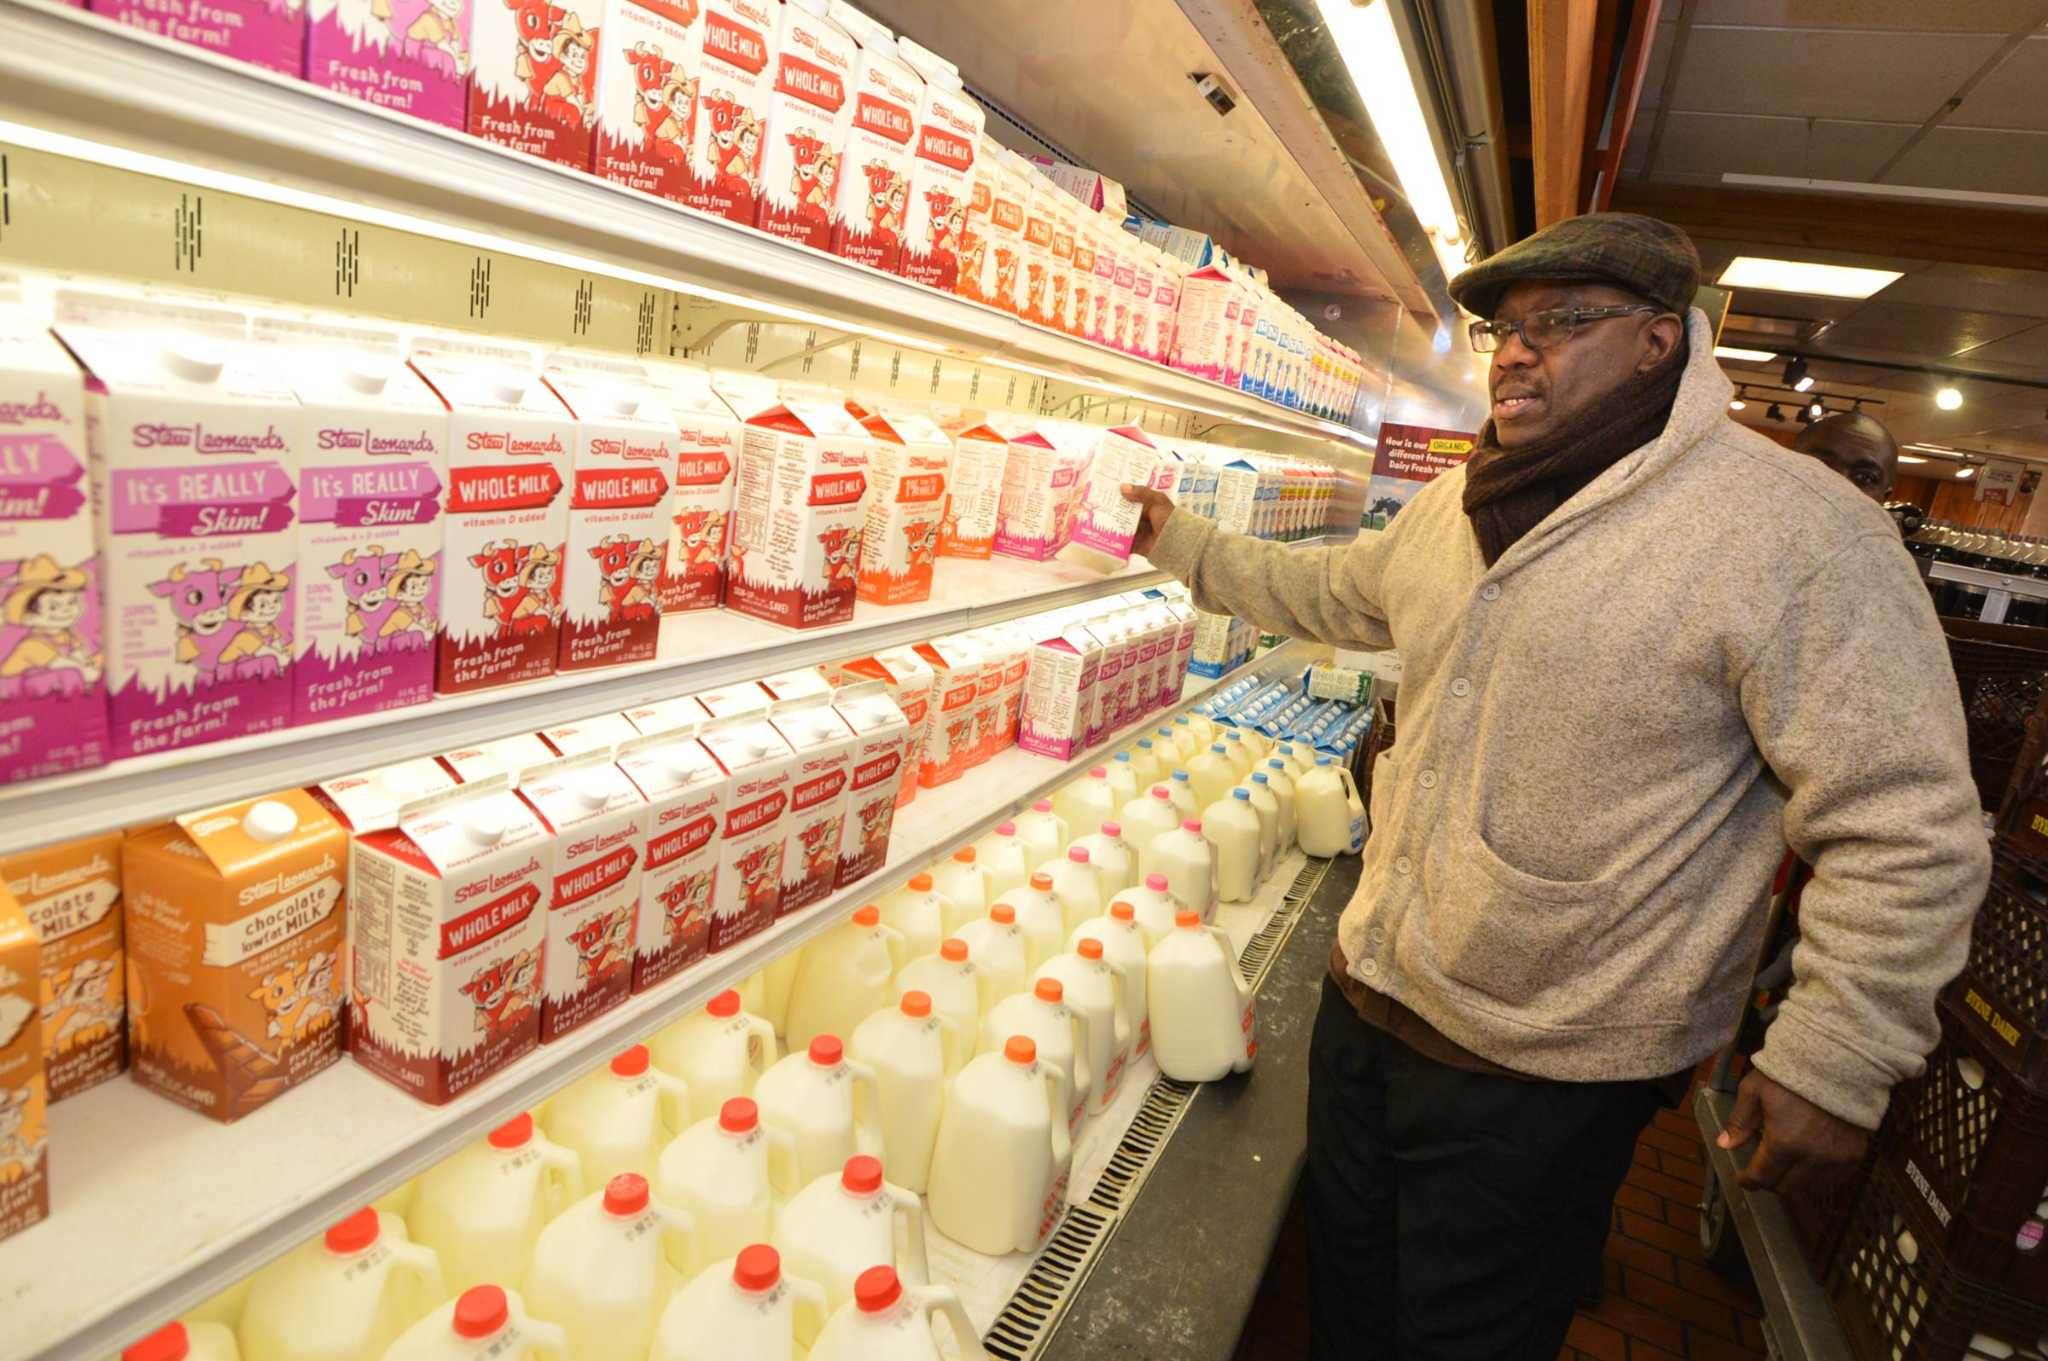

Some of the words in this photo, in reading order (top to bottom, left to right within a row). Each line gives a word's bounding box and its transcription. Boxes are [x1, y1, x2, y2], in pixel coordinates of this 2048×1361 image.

[739, 36, 761, 60] MILK
[328, 60, 379, 84] Fresh
[381, 70, 423, 92] from
[784, 66, 819, 94] WHOLE
[820, 76, 840, 100] MILK
[366, 86, 413, 109] farm!
[482, 115, 520, 134] Fresh
[523, 123, 555, 139] from
[862, 104, 891, 128] WHOLE
[892, 115, 909, 133] MILK
[510, 137, 547, 154] farm!
[925, 135, 953, 158] WHOLE
[953, 145, 969, 161] MILK
[606, 157, 637, 172] Fresh
[639, 162, 664, 176] from
[628, 175, 658, 190] farm!
[688, 194, 709, 206] resh
[710, 195, 732, 208] from
[768, 220, 792, 233] Fresh
[792, 223, 812, 235] from
[132, 423, 193, 448] Stew
[317, 429, 364, 450] Stew
[467, 432, 505, 450] Stew
[590, 439, 621, 455] Stew
[1385, 436, 1403, 446] How
[1404, 439, 1412, 448] is
[1433, 441, 1466, 451] ORGANIC
[679, 460, 704, 478] HOLE
[704, 461, 724, 475] MILK
[1388, 448, 1425, 460] different
[1426, 453, 1446, 464] from
[1388, 460, 1410, 472] Dairy
[1411, 463, 1433, 474] Fresh
[126, 476, 168, 506] It's
[179, 469, 266, 501] REALLY
[313, 474, 343, 498] It's
[352, 469, 418, 495] REALLY
[459, 474, 517, 503] WHOLE
[518, 475, 551, 495] MILK
[582, 477, 631, 501] WHOLE
[631, 477, 658, 494] MILK
[815, 480, 845, 499] WHOLE
[845, 479, 861, 493] MILK
[191, 506, 269, 537] Skim!
[360, 500, 420, 525] Skim!
[571, 634, 604, 650] Fresh
[604, 628, 631, 643] from
[572, 649, 593, 662] the
[593, 639, 624, 659] farm!
[453, 652, 492, 670] Fresh
[493, 643, 525, 662] from
[454, 669, 478, 683] the
[479, 656, 517, 680] farm!
[308, 675, 352, 697] Fresh
[355, 665, 393, 687] from
[310, 697, 336, 712] the
[340, 679, 384, 707] farm!
[130, 709, 188, 736] Fresh
[190, 696, 239, 723] from
[132, 733, 166, 752] the
[171, 712, 228, 745] farm!
[857, 764, 881, 784] WHOLE
[796, 782, 824, 805] WHOLE
[825, 776, 841, 792] MILK
[731, 804, 763, 831] WHOLE
[764, 797, 781, 816] MILK
[653, 836, 688, 862] WHOLE
[689, 822, 709, 843] MILK
[560, 866, 603, 899] WHOLE
[605, 854, 629, 877] MILK
[28, 891, 96, 924] colate
[245, 887, 326, 936] chocolate
[449, 907, 500, 947] WHOLE
[501, 892, 530, 921] MILK
[42, 907, 91, 937] MILK
[241, 926, 284, 953] lowfat
[286, 902, 322, 935] MILK
[1991, 1012, 2021, 1047] DAIRY
[1927, 1189, 1952, 1229] DAIRY
